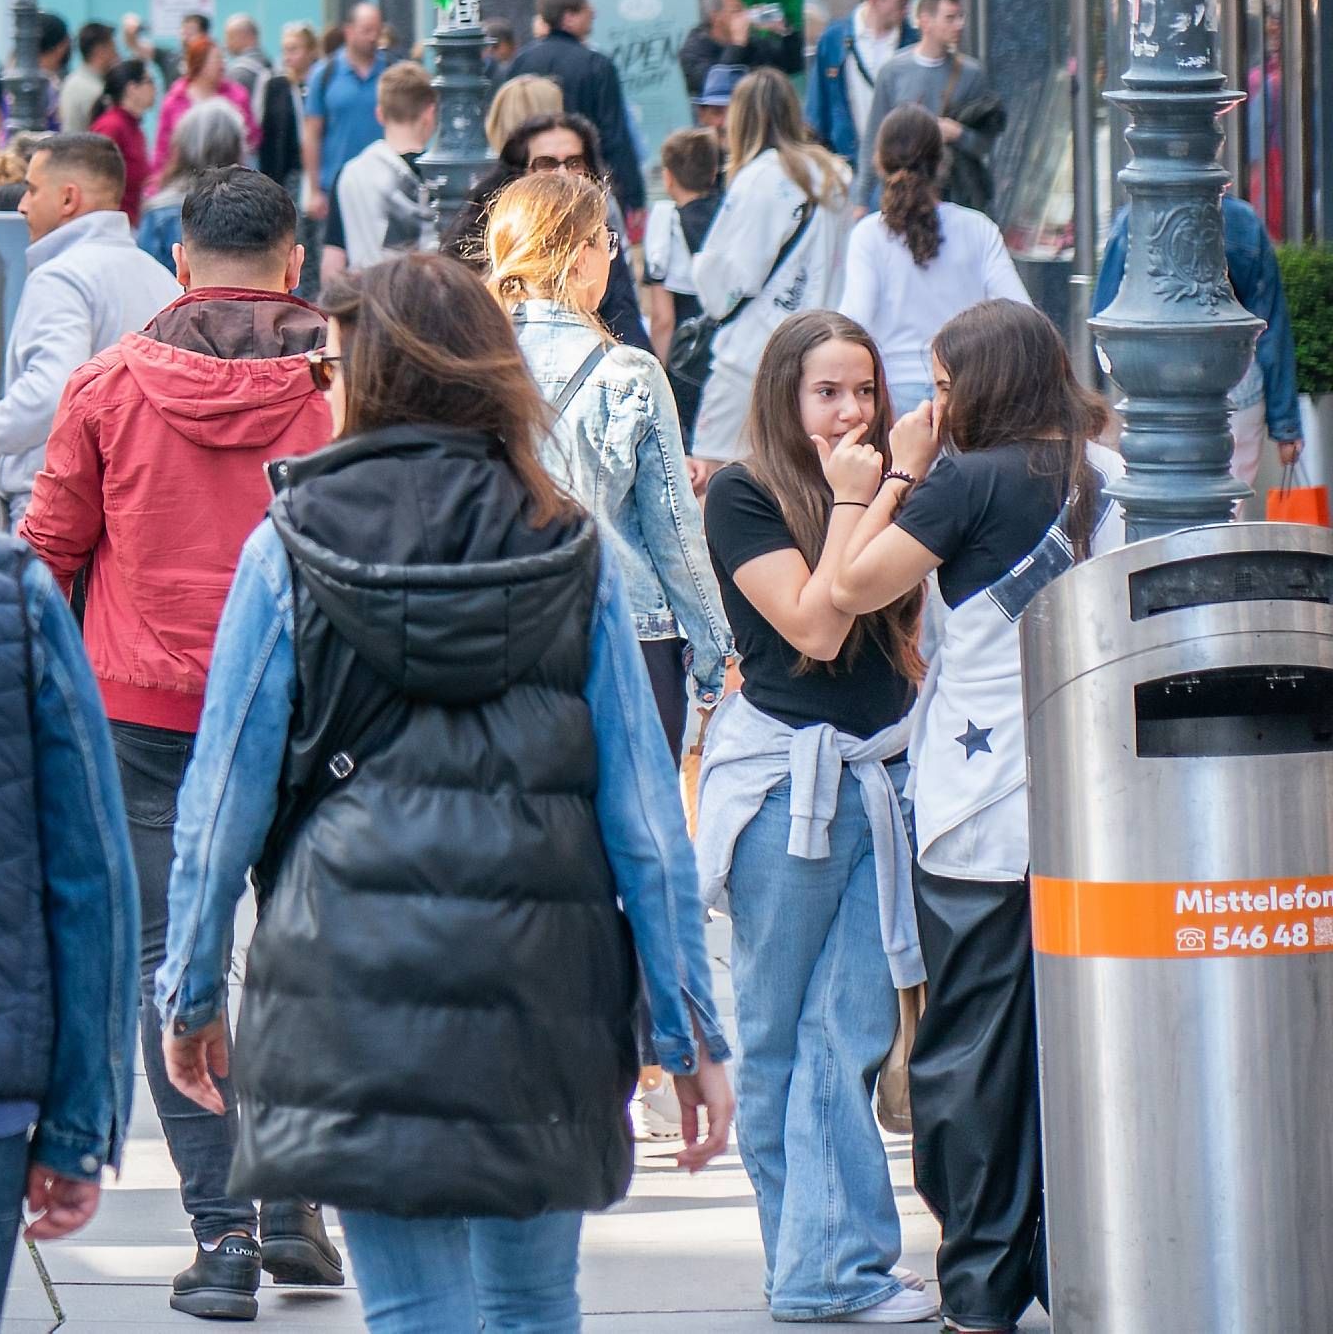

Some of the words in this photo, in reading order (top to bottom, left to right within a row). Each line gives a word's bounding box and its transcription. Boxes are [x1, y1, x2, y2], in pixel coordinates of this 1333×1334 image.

[1175, 884, 1333, 914] Misttelefon
[1212, 925, 1268, 950] 546
[1273, 922, 1309, 947] 48
